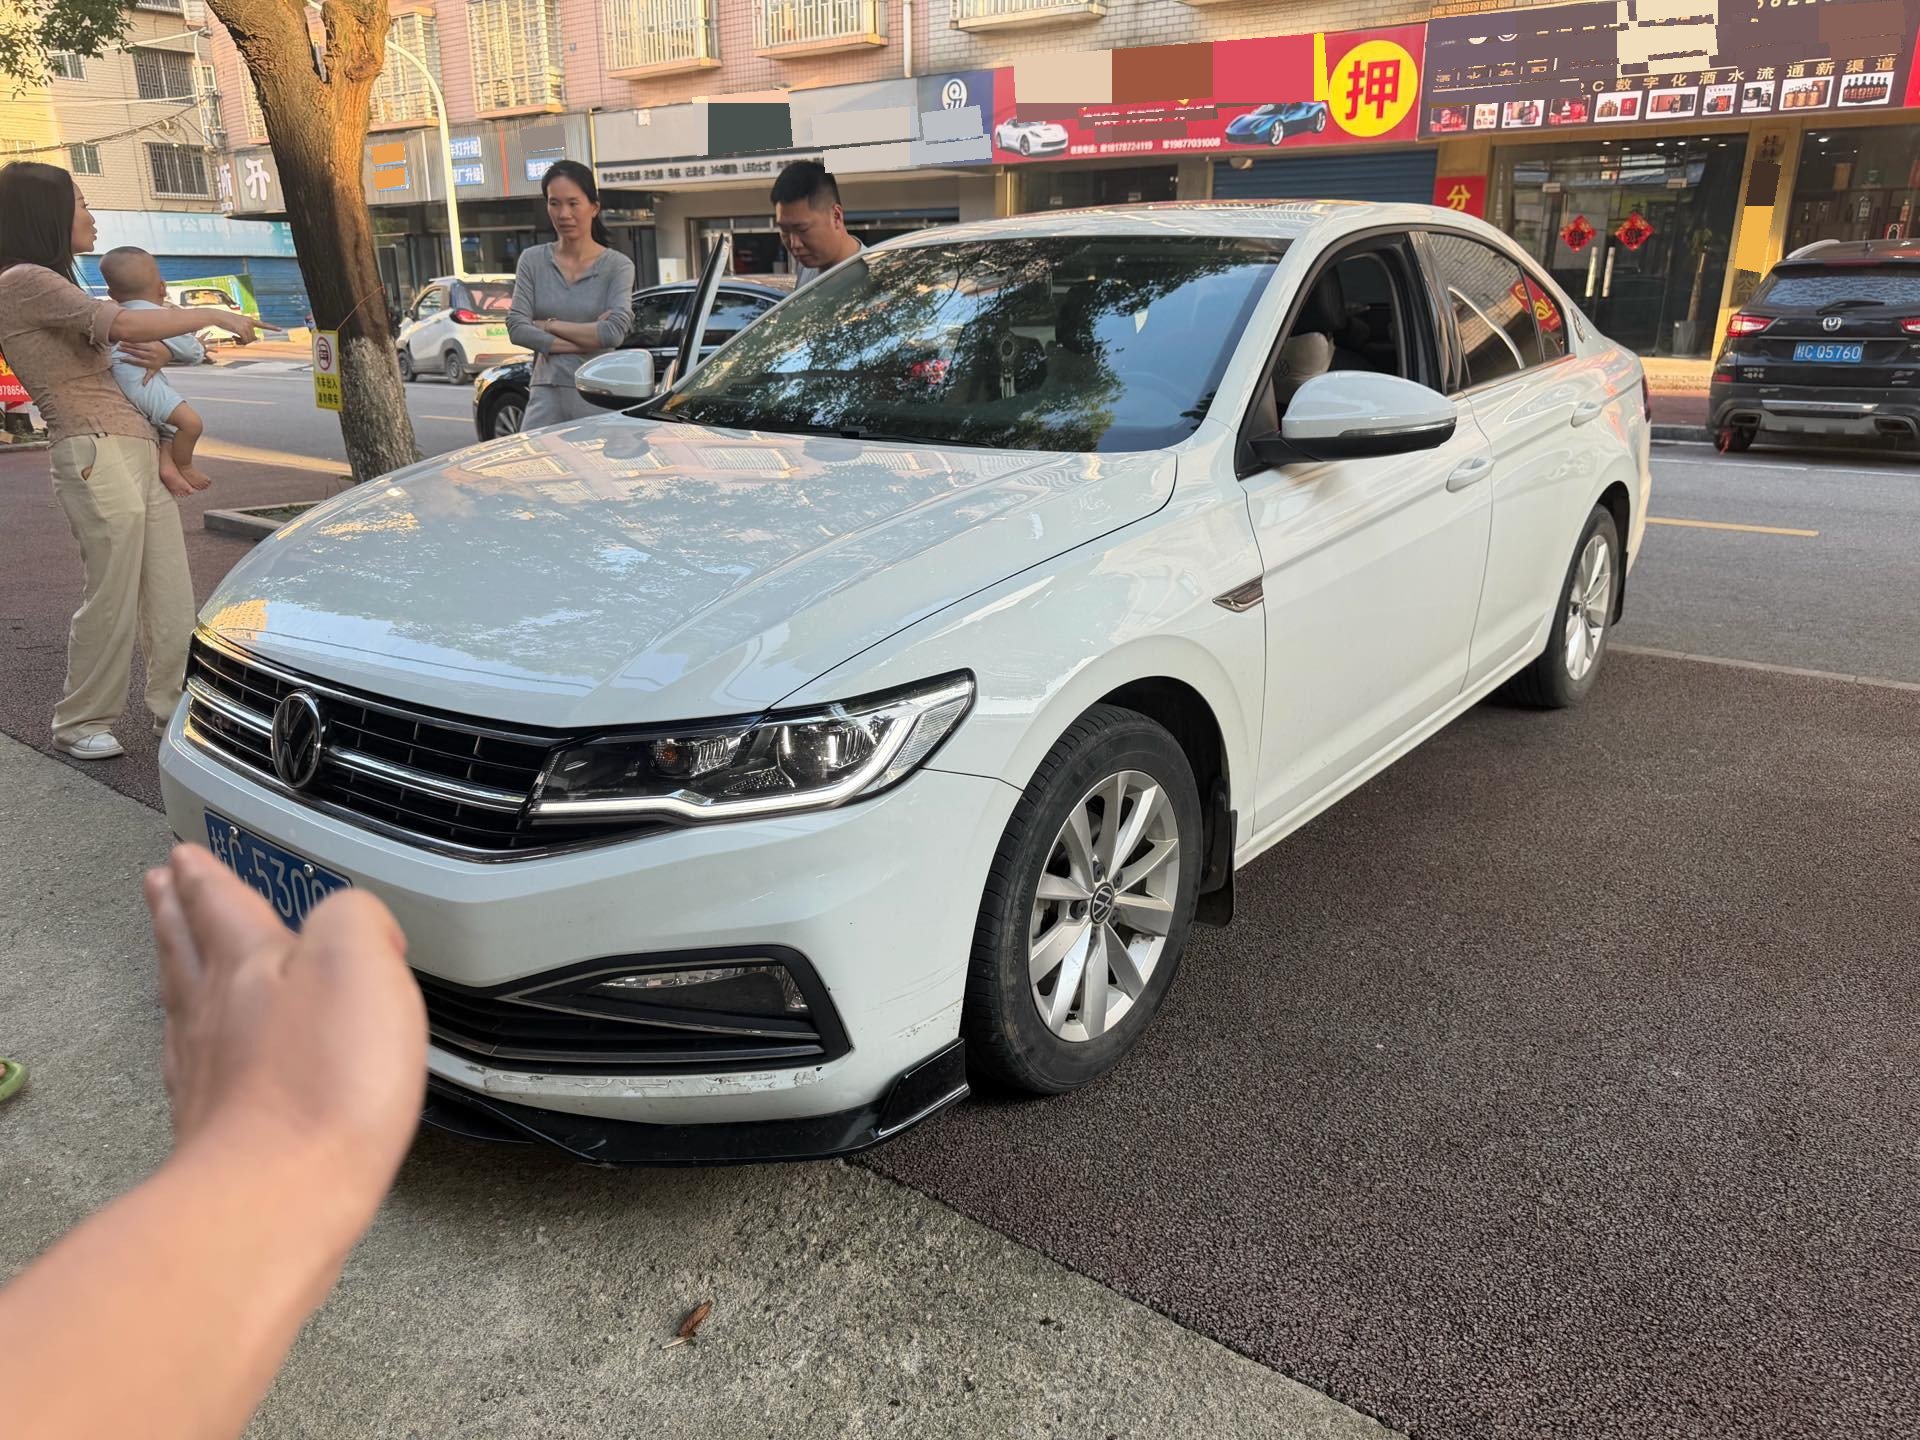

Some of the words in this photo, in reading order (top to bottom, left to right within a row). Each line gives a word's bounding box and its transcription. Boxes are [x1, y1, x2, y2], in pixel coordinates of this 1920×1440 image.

[1344, 58, 1401, 120] 押
[245, 158, 271, 201] 开
[1446, 184, 1472, 210] 分
